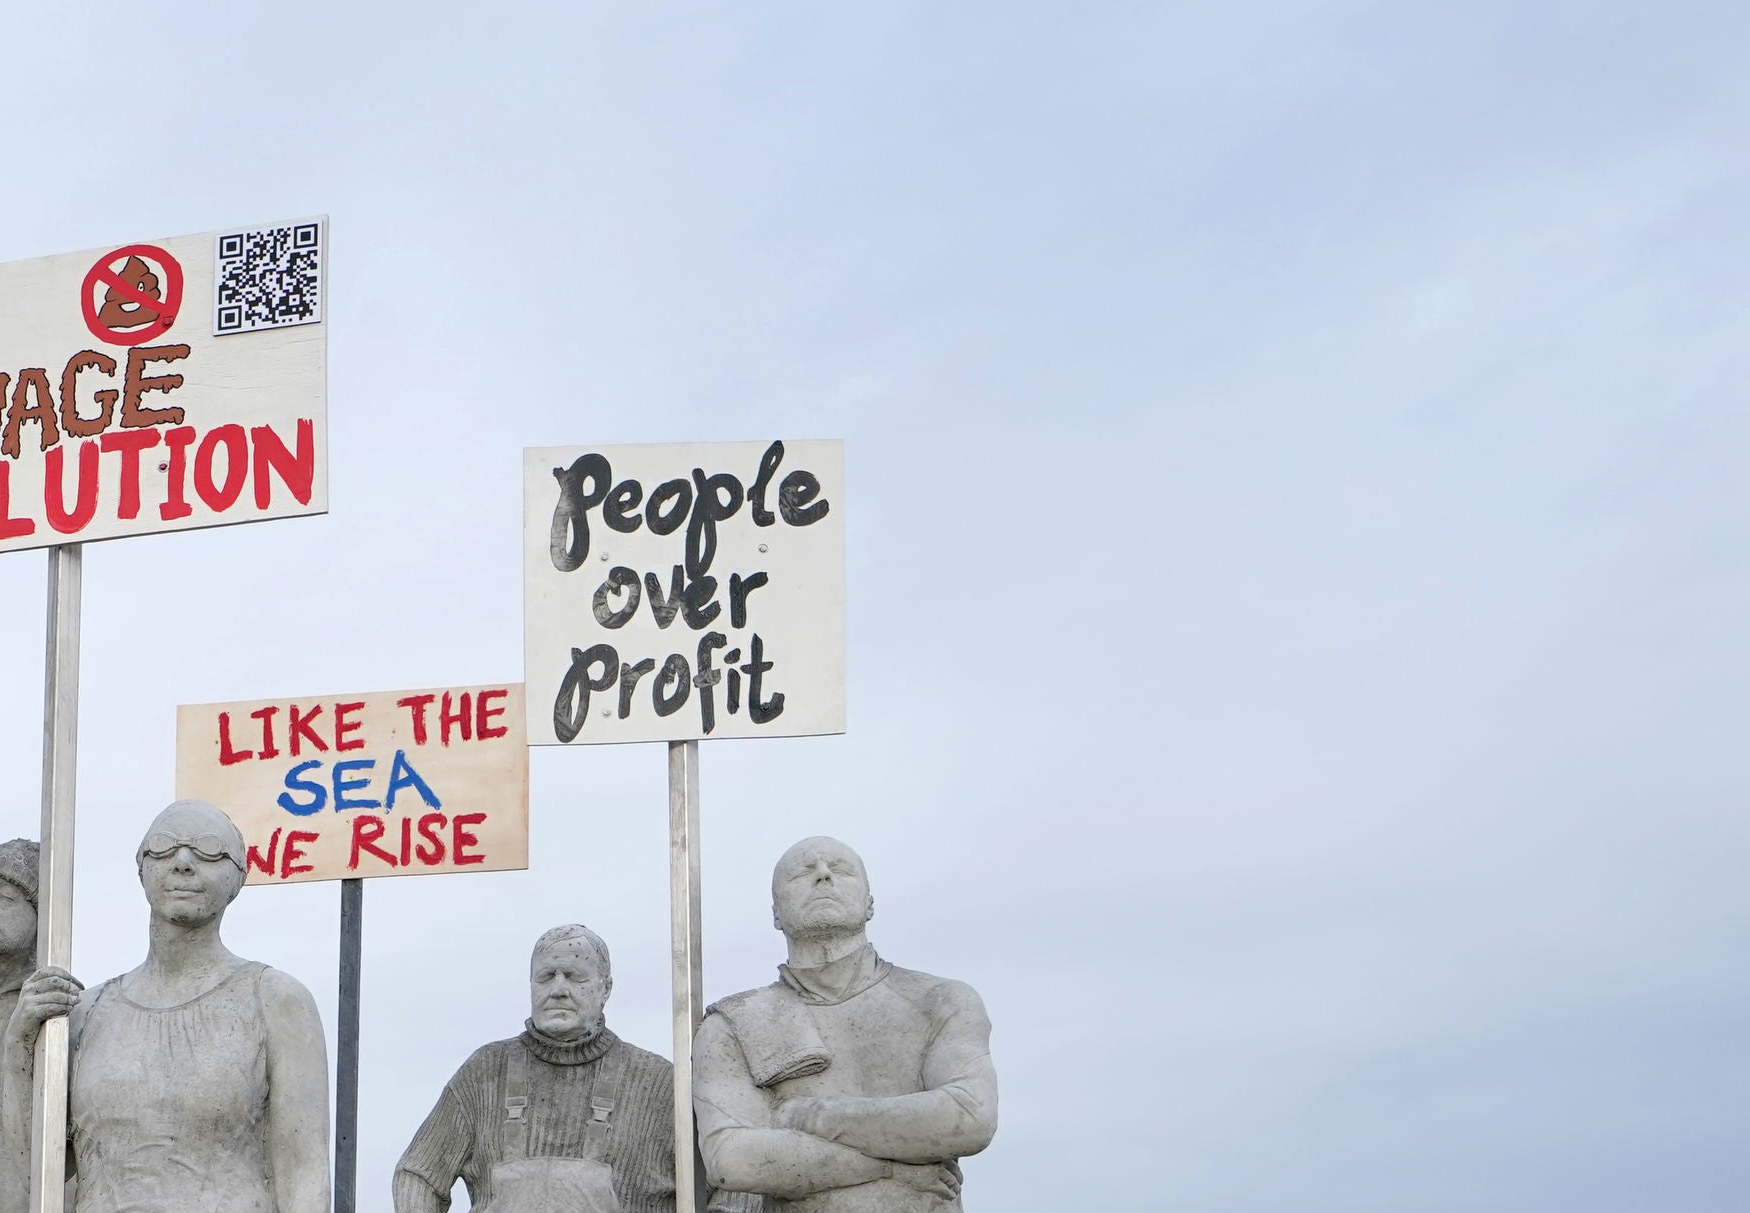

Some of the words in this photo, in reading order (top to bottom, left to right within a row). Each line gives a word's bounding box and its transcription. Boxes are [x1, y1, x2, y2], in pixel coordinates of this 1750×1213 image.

[592, 564, 769, 630] over
[553, 631, 786, 743] profit
[218, 702, 366, 766] LIKE
[397, 689, 509, 747] THE
[277, 750, 441, 816] SEA
[349, 812, 487, 870] RISE
